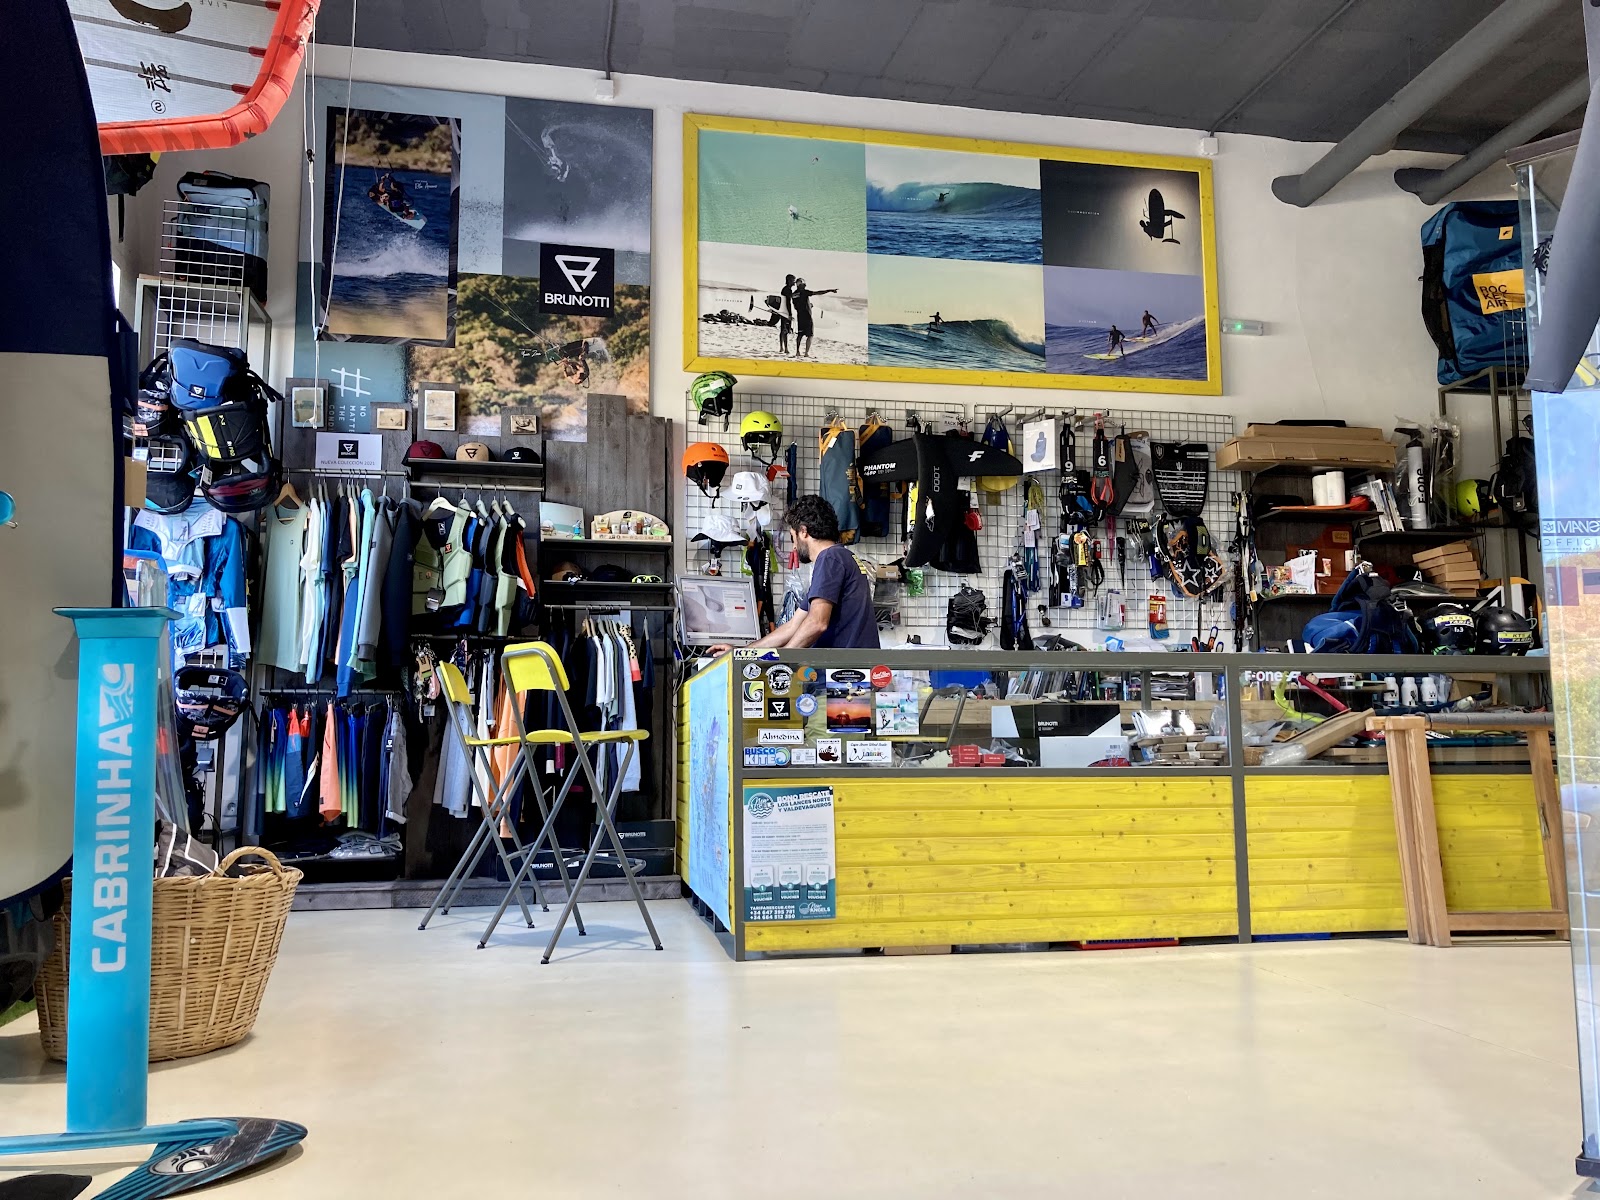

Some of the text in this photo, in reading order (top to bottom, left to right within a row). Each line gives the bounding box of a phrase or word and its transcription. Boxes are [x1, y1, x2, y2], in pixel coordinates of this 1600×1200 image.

[1479, 284, 1507, 298] ROC
[544, 292, 610, 309] BRUNOTTI
[1486, 299, 1508, 310] AIR
[338, 405, 346, 422] THE
[360, 405, 367, 417] NO
[863, 462, 897, 472] PHANTOM
[1064, 461, 1074, 472] 9
[1097, 455, 1107, 467] 6
[1416, 468, 1426, 504] F-one
[1244, 670, 1283, 682] F-one
[744, 747, 776, 755] BUSCO
[745, 754, 777, 766] KITE
[777, 795, 798, 803] BONO
[783, 801, 832, 812] VALDEVAQUEROS
[92, 723, 133, 973] CABRINHA
